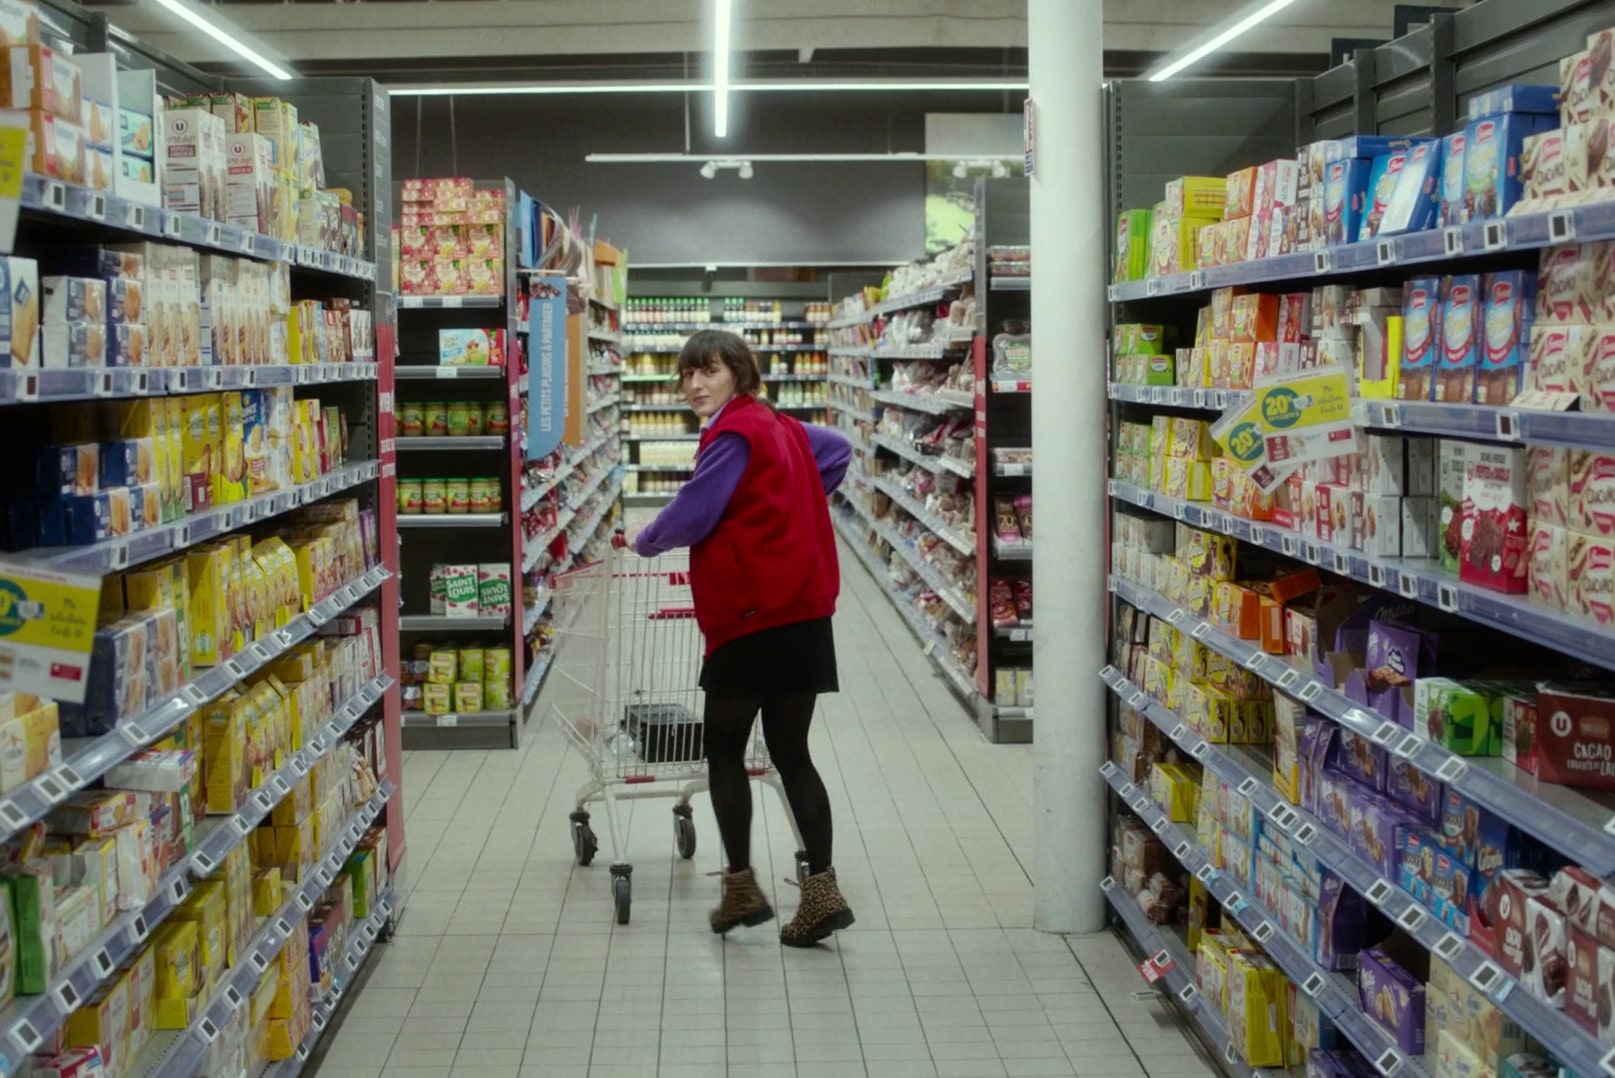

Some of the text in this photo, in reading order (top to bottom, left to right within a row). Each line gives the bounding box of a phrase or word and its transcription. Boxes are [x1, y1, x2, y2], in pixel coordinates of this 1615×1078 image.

[541, 389, 552, 416] PETITS
[541, 416, 552, 432] LES
[446, 577, 473, 588] SAINT
[448, 586, 475, 599] LOUIS
[481, 583, 508, 596] LOUIS
[482, 595, 509, 605] SAINT
[1574, 742, 1612, 761] CACAO
